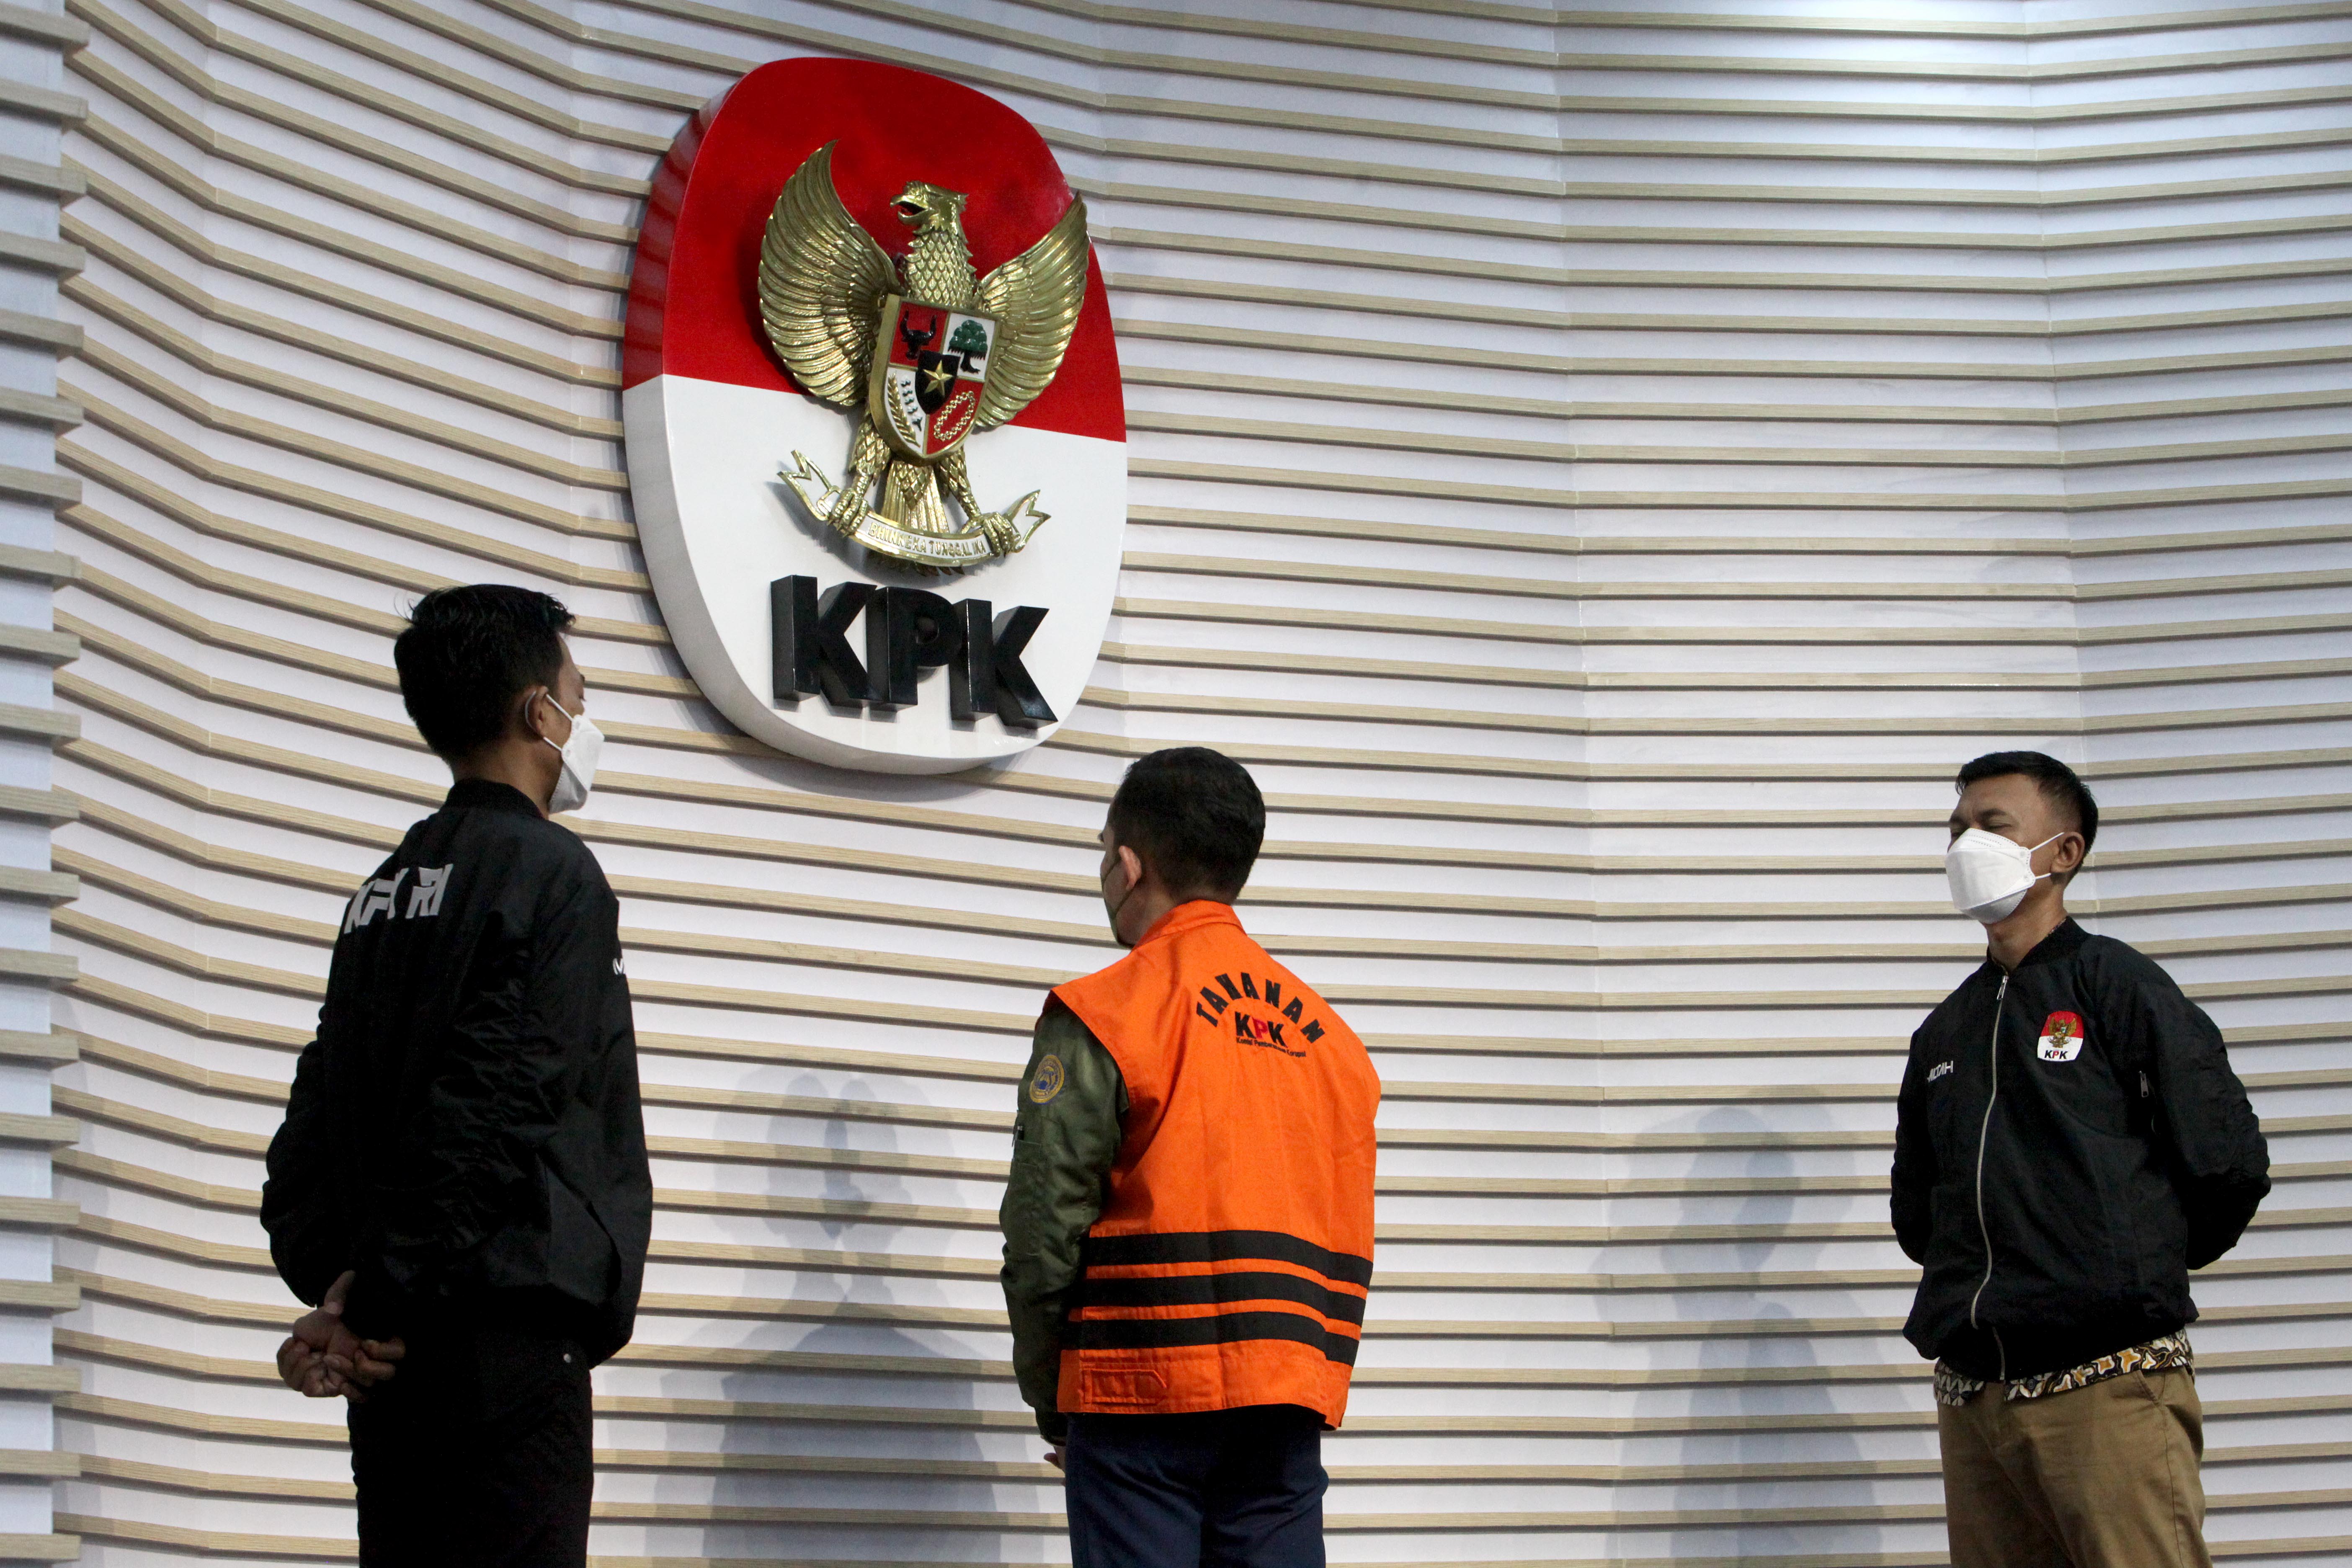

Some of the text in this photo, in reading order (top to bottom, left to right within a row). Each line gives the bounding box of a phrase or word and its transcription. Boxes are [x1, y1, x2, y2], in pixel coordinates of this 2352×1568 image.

[867, 522, 926, 553] BHINNEKA
[928, 539, 972, 557] TUNGGAL
[771, 575, 1059, 730] KPK
[405, 863, 454, 919] RI
[1197, 972, 1326, 1044] TAHANAN
[1235, 1011, 1288, 1048] KPK
[2044, 1050, 2068, 1060] KPK
